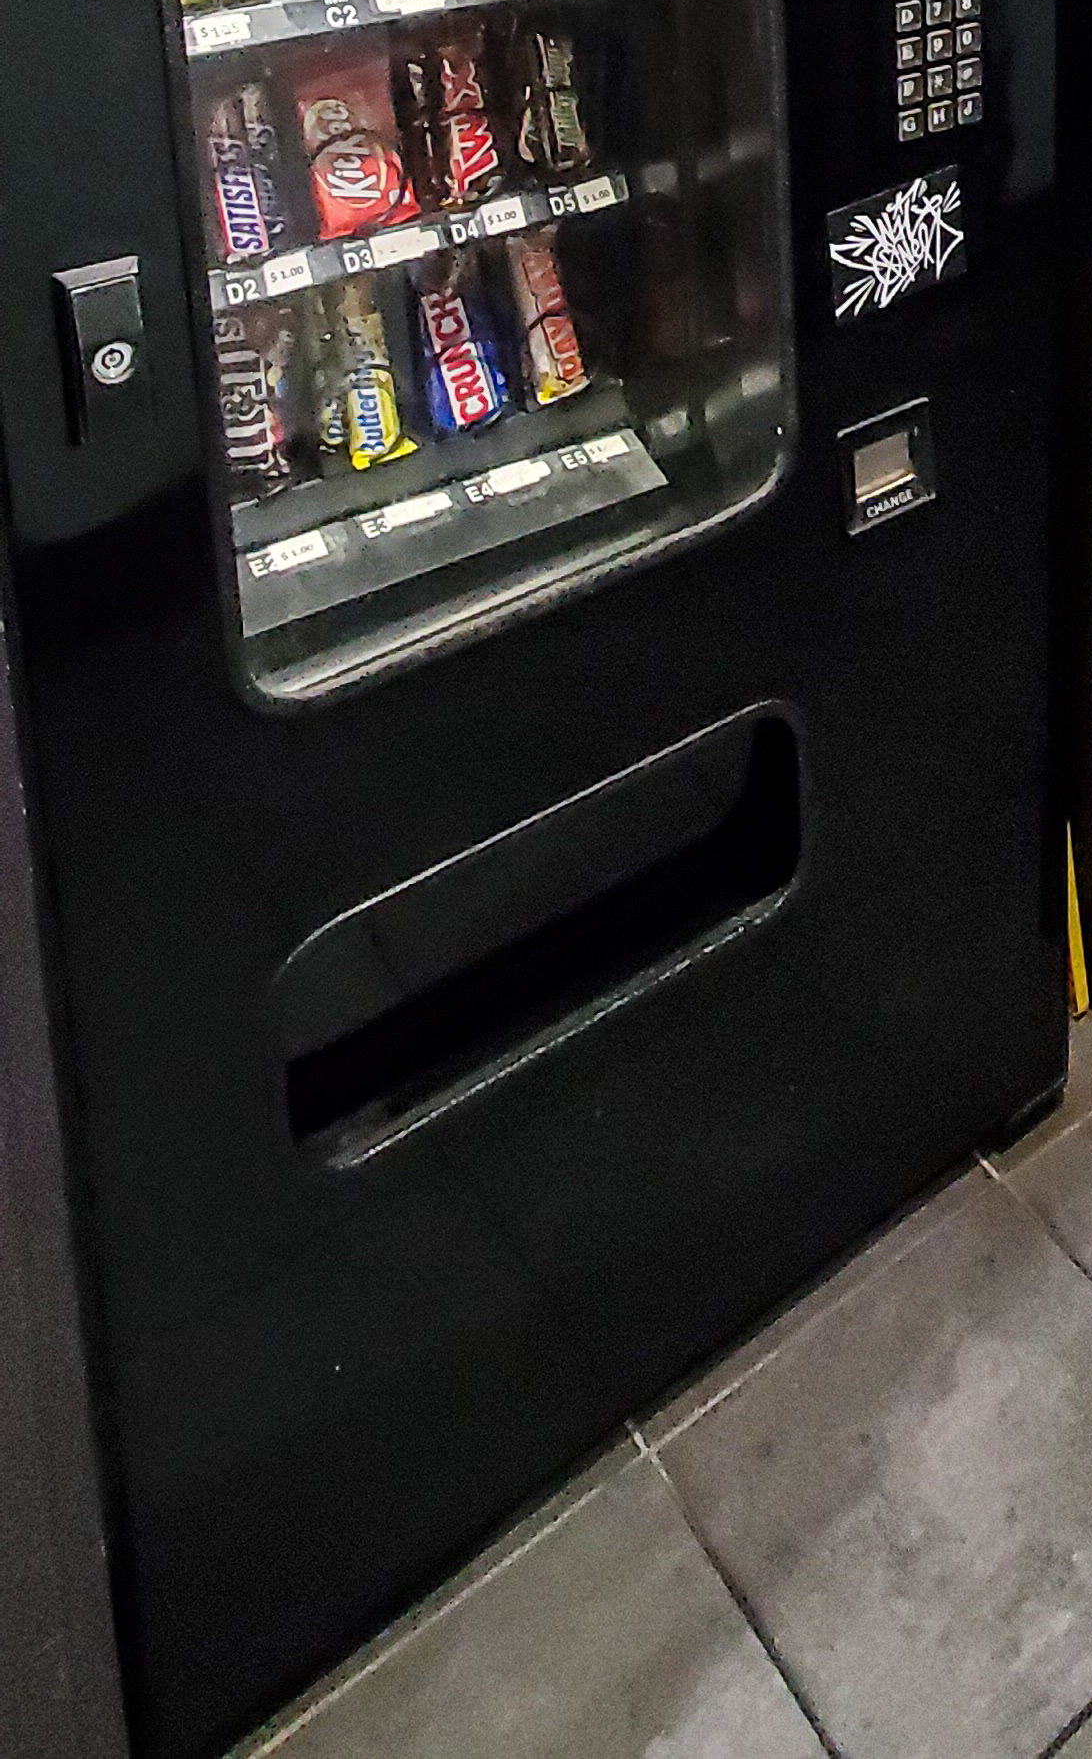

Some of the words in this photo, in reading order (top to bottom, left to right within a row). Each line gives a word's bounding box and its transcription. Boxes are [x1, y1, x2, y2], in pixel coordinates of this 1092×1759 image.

[325, 4, 360, 28] C2
[549, 192, 576, 217] D5
[451, 220, 480, 245] D4
[343, 248, 374, 274] D3
[225, 278, 261, 306] D2
[562, 448, 589, 471] E5
[465, 482, 495, 505] E4
[866, 488, 914, 520] CHANGE
[361, 517, 394, 540] E3
